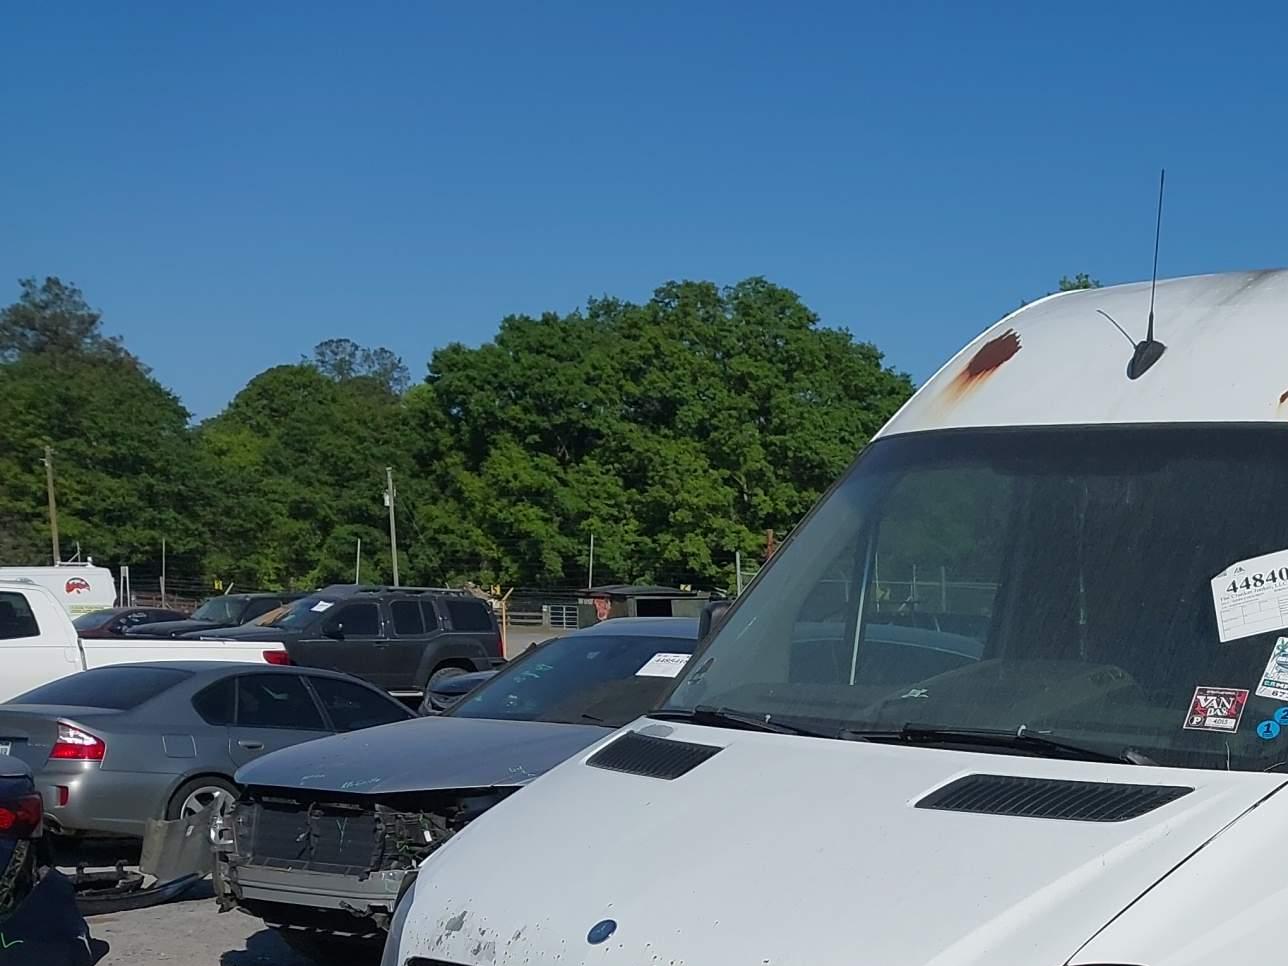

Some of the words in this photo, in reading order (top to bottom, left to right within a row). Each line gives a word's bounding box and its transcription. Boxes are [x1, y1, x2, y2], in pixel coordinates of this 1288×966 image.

[1196, 695, 1236, 709] VAN
[1191, 716, 1202, 725] P
[1263, 722, 1273, 734] 1
